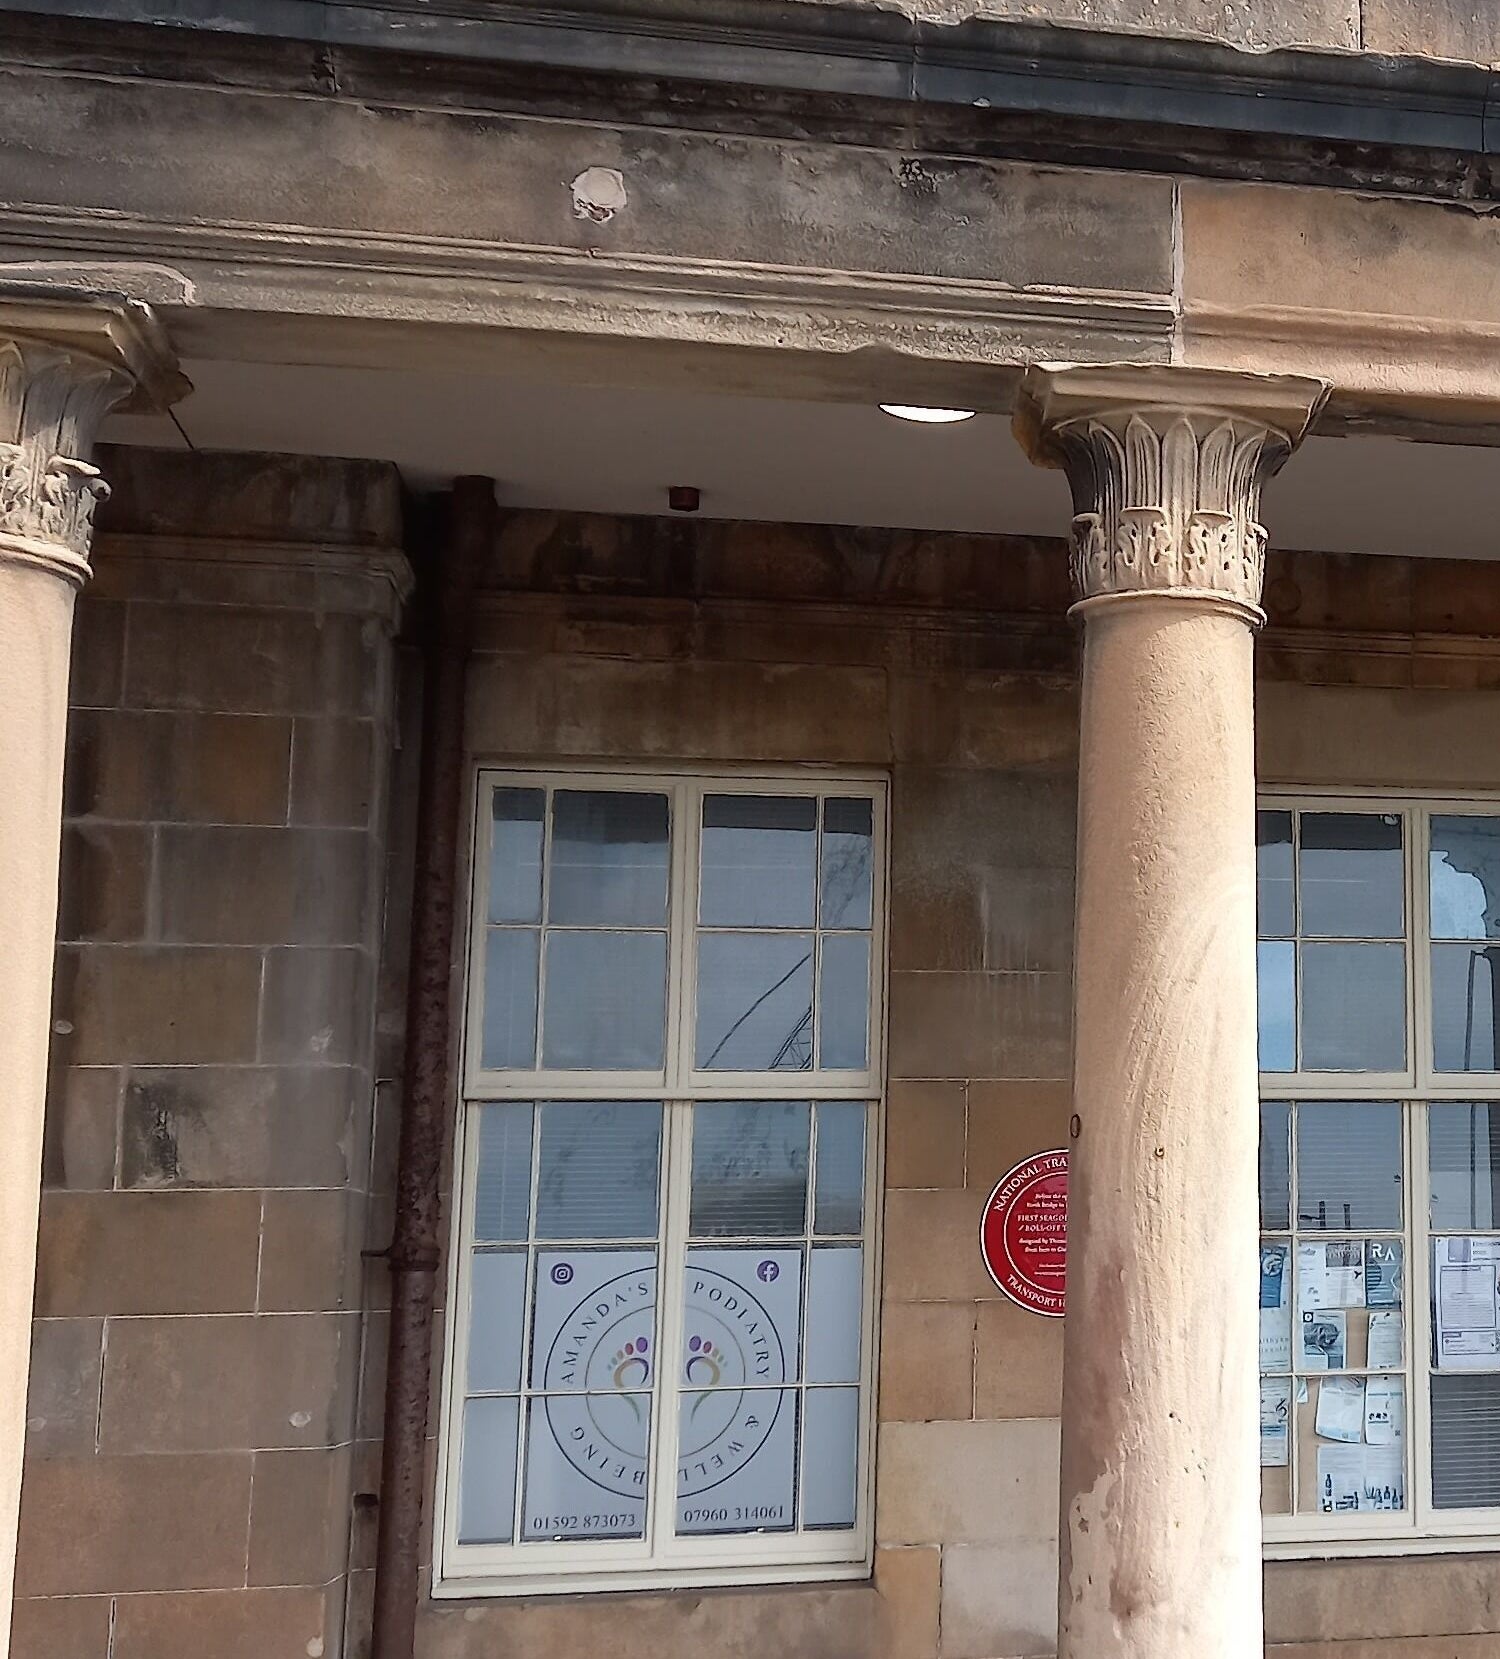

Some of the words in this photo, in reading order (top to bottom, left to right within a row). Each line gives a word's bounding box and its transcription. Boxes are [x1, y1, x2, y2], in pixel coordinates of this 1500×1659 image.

[993, 1164, 1042, 1211] NATIONAL
[1042, 1157, 1067, 1169] TRA
[1007, 1274, 1056, 1307] TRANSPORT
[561, 1281, 649, 1385] AMANDA'S
[692, 1281, 770, 1379] PODIATRY
[570, 1426, 647, 1485] BEING
[533, 1516, 577, 1530] 01592
[582, 1513, 636, 1528] 873073
[683, 1508, 728, 1522] 07960
[735, 1505, 784, 1520] 314061
